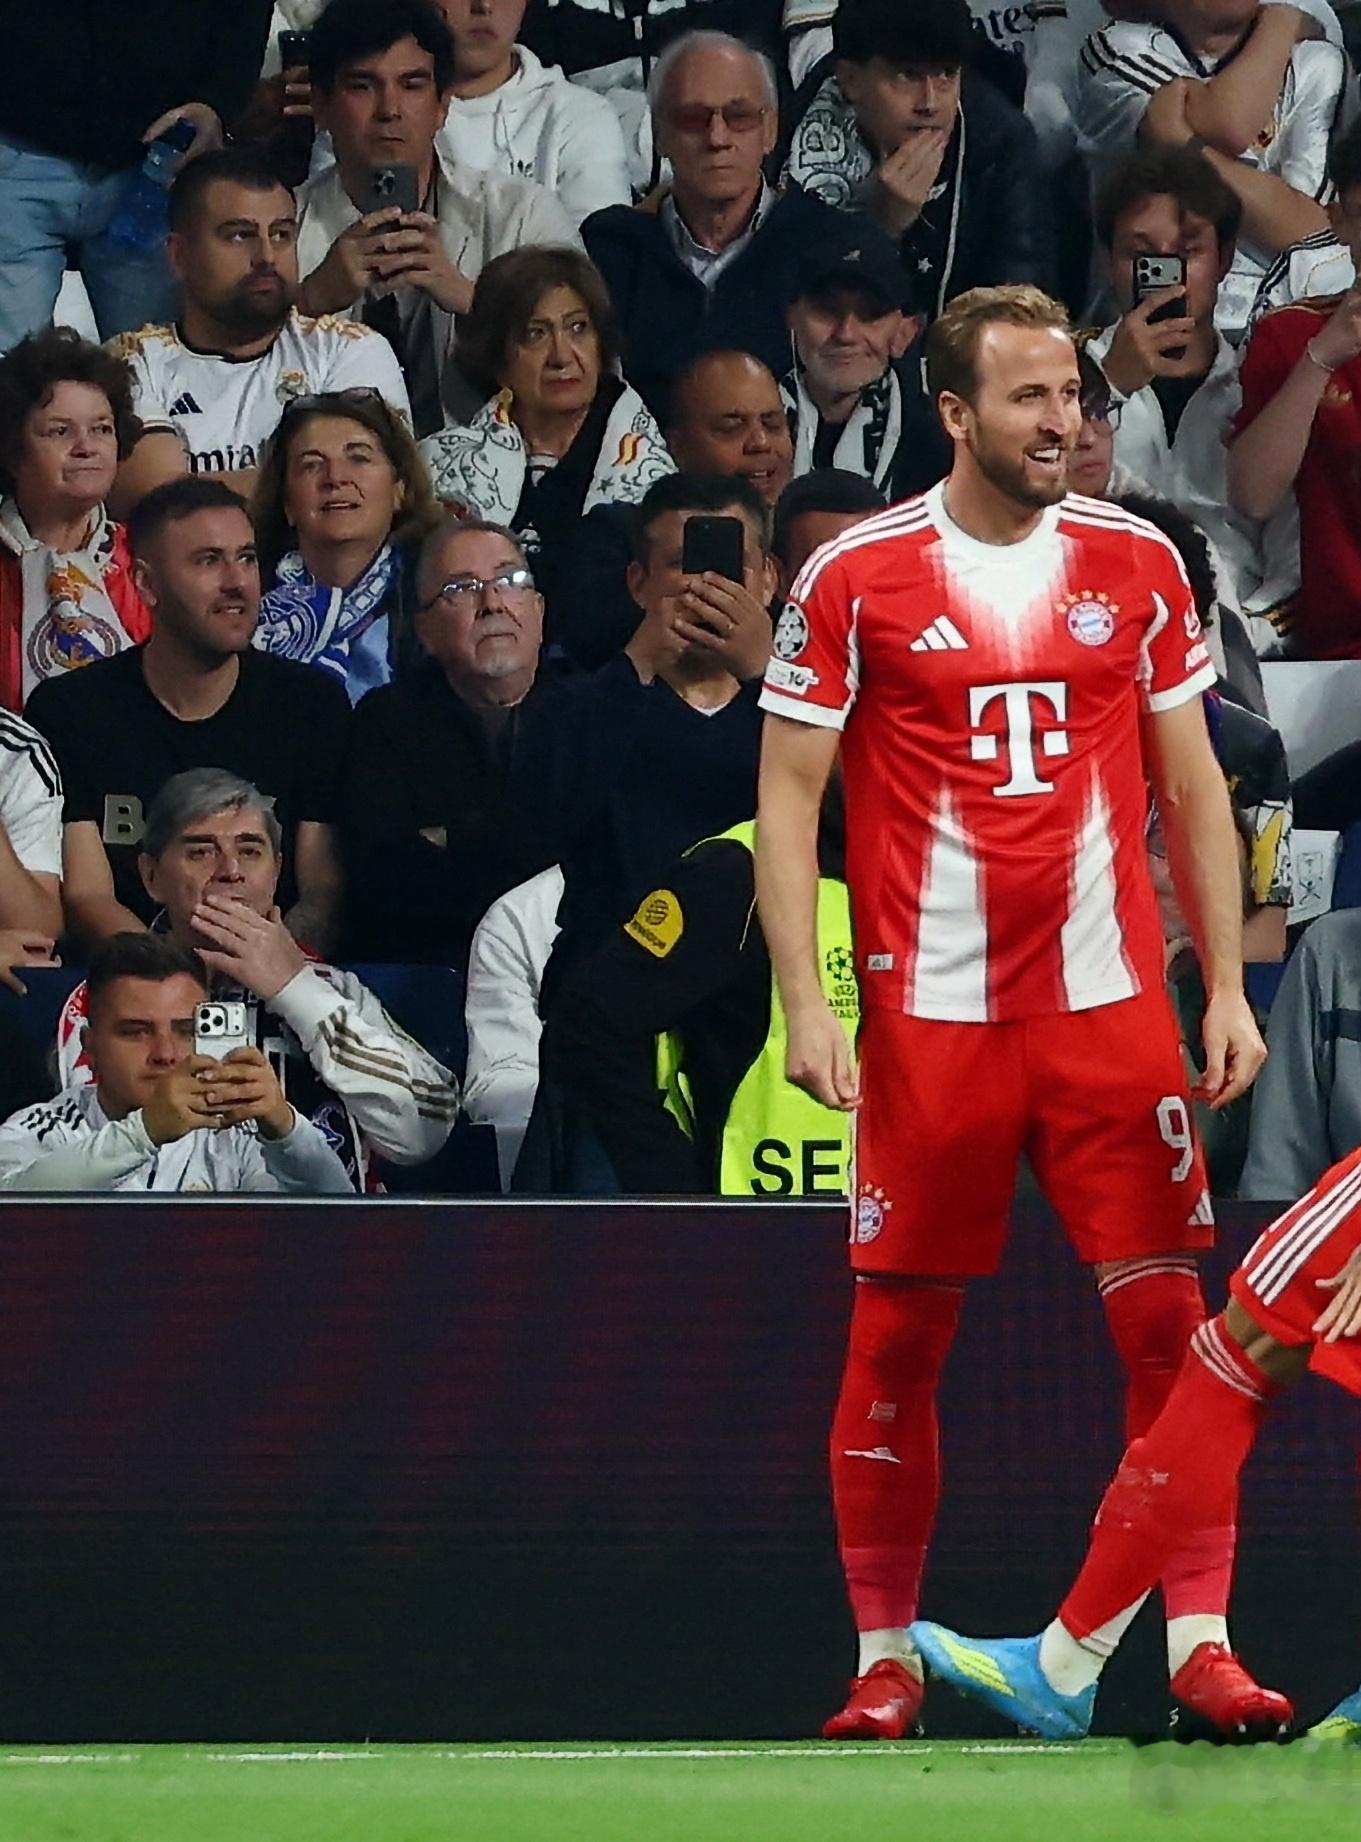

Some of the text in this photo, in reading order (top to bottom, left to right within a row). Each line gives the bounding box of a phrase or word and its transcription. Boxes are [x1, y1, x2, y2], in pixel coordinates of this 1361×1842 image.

[968, 681, 1070, 797] T
[750, 1138, 843, 1196] SE
[1155, 1094, 1195, 1183] 9
